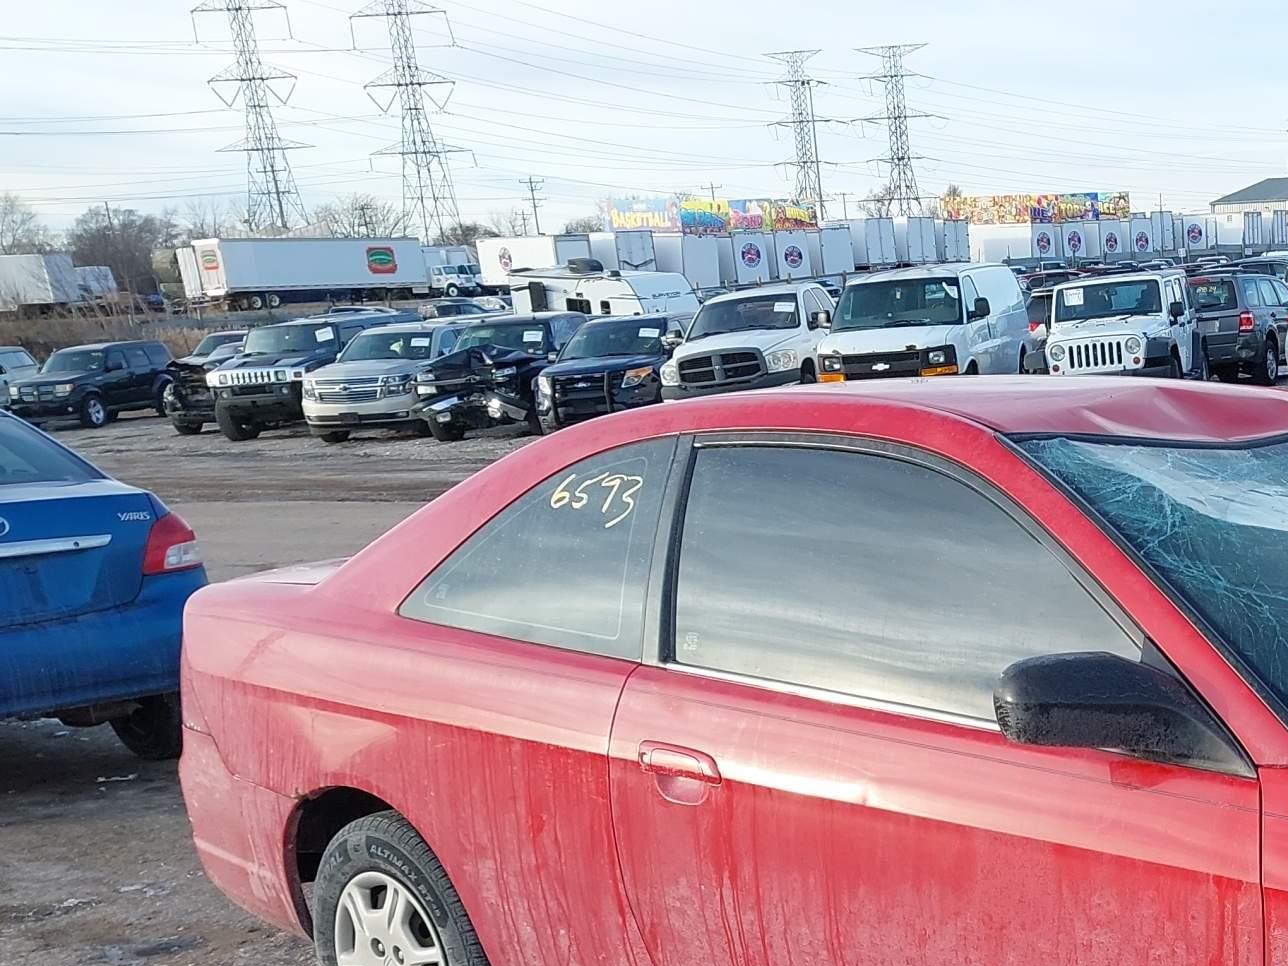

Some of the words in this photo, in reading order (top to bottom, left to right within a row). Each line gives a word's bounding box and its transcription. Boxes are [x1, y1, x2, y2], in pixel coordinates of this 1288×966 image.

[117, 511, 151, 521] YARIS
[551, 471, 644, 529] 6593
[369, 844, 418, 882] ALTIMAX
